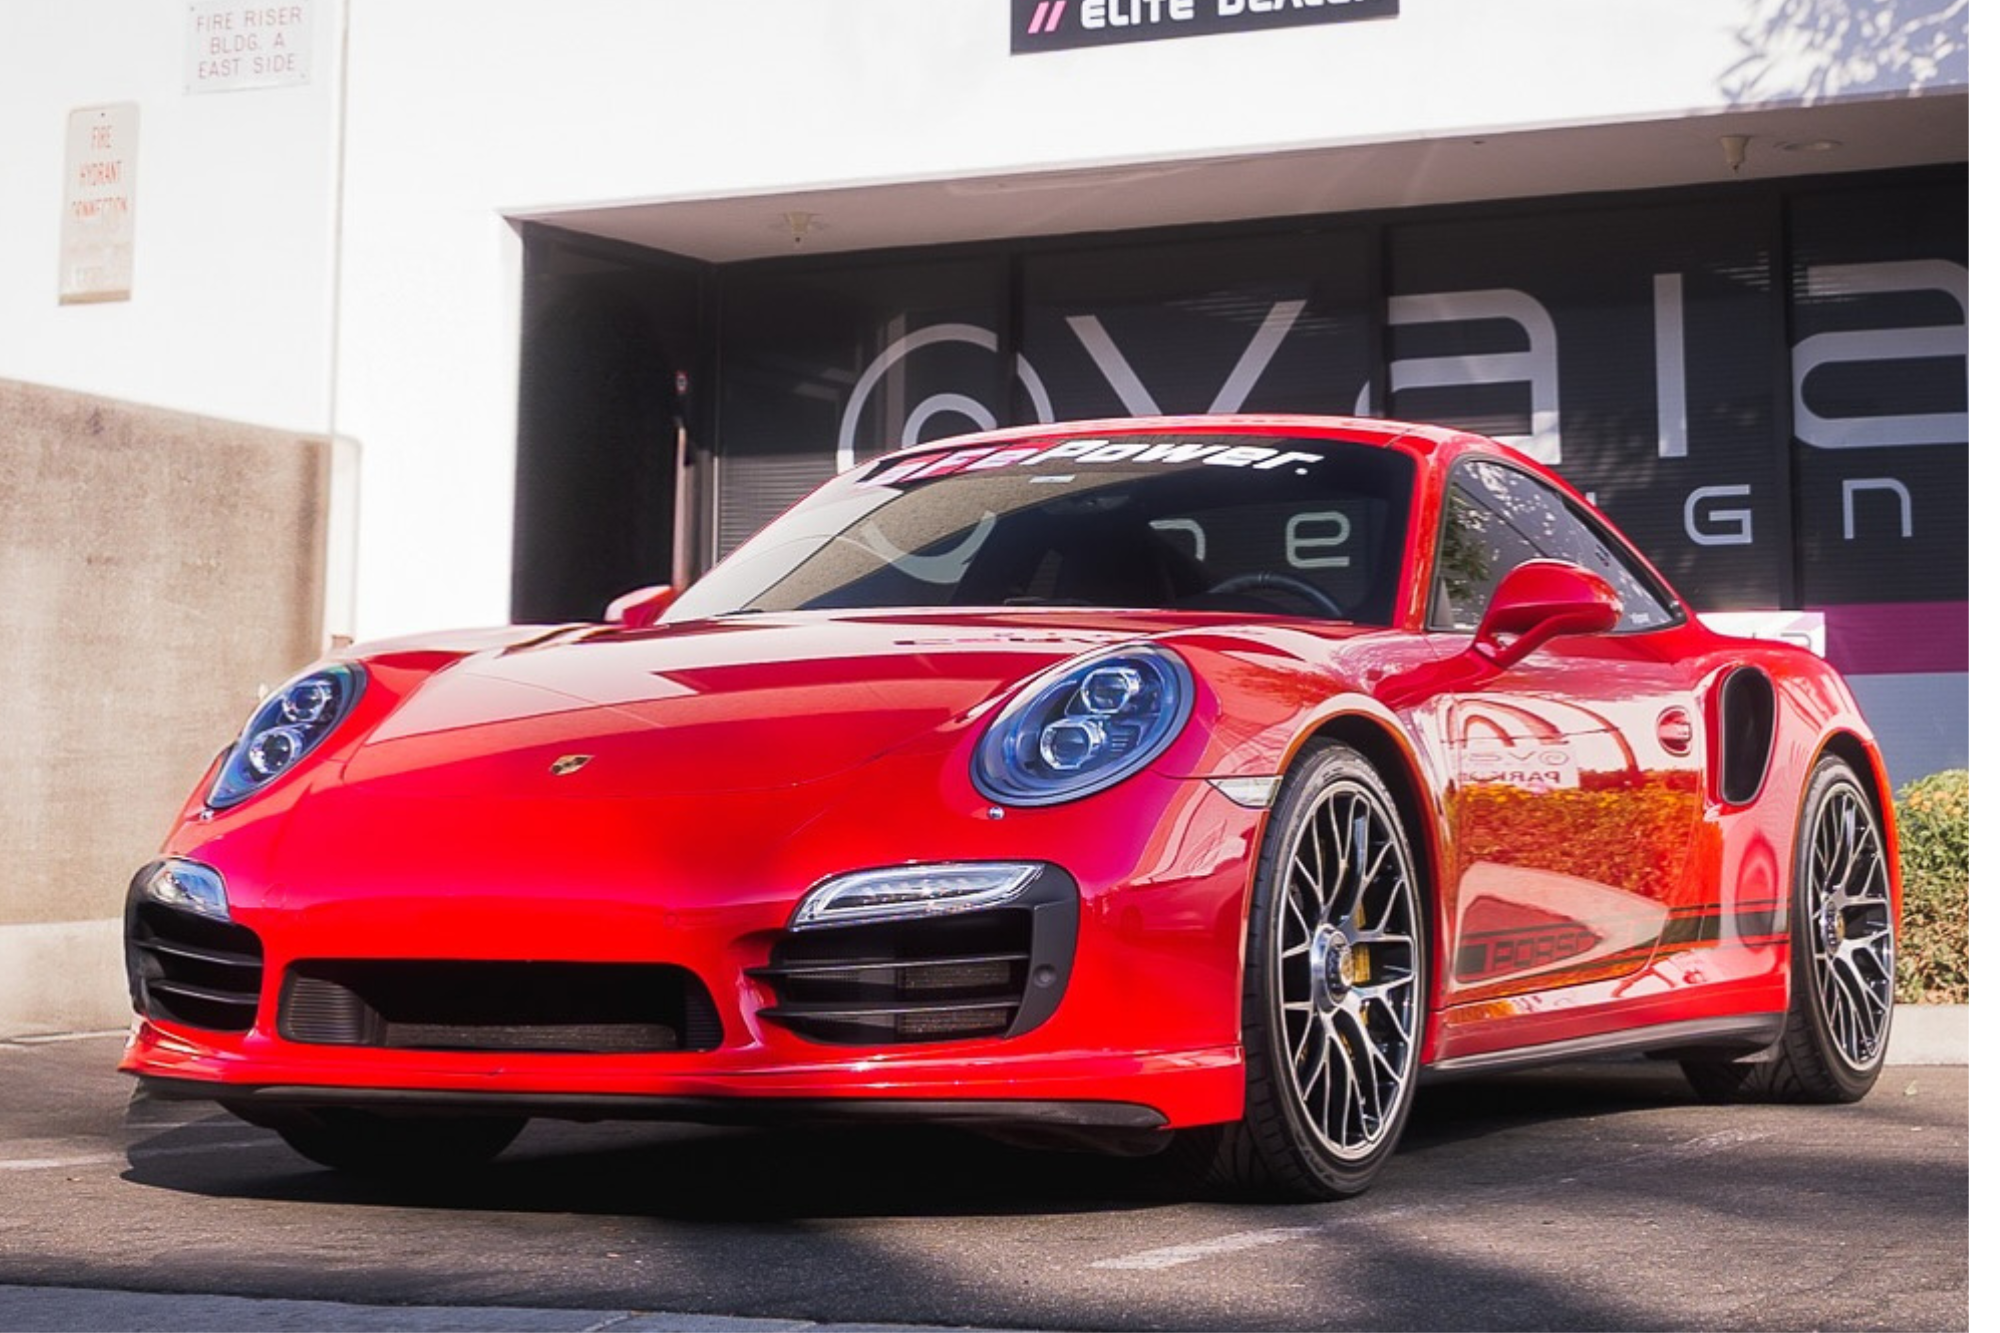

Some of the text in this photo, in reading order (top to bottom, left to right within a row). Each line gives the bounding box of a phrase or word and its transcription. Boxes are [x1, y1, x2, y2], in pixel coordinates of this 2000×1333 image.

[196, 6, 303, 33] FIRE RISER
[1081, 0, 1195, 29] ELITE
[273, 32, 286, 48] A
[197, 53, 296, 80] EAST SIDE
